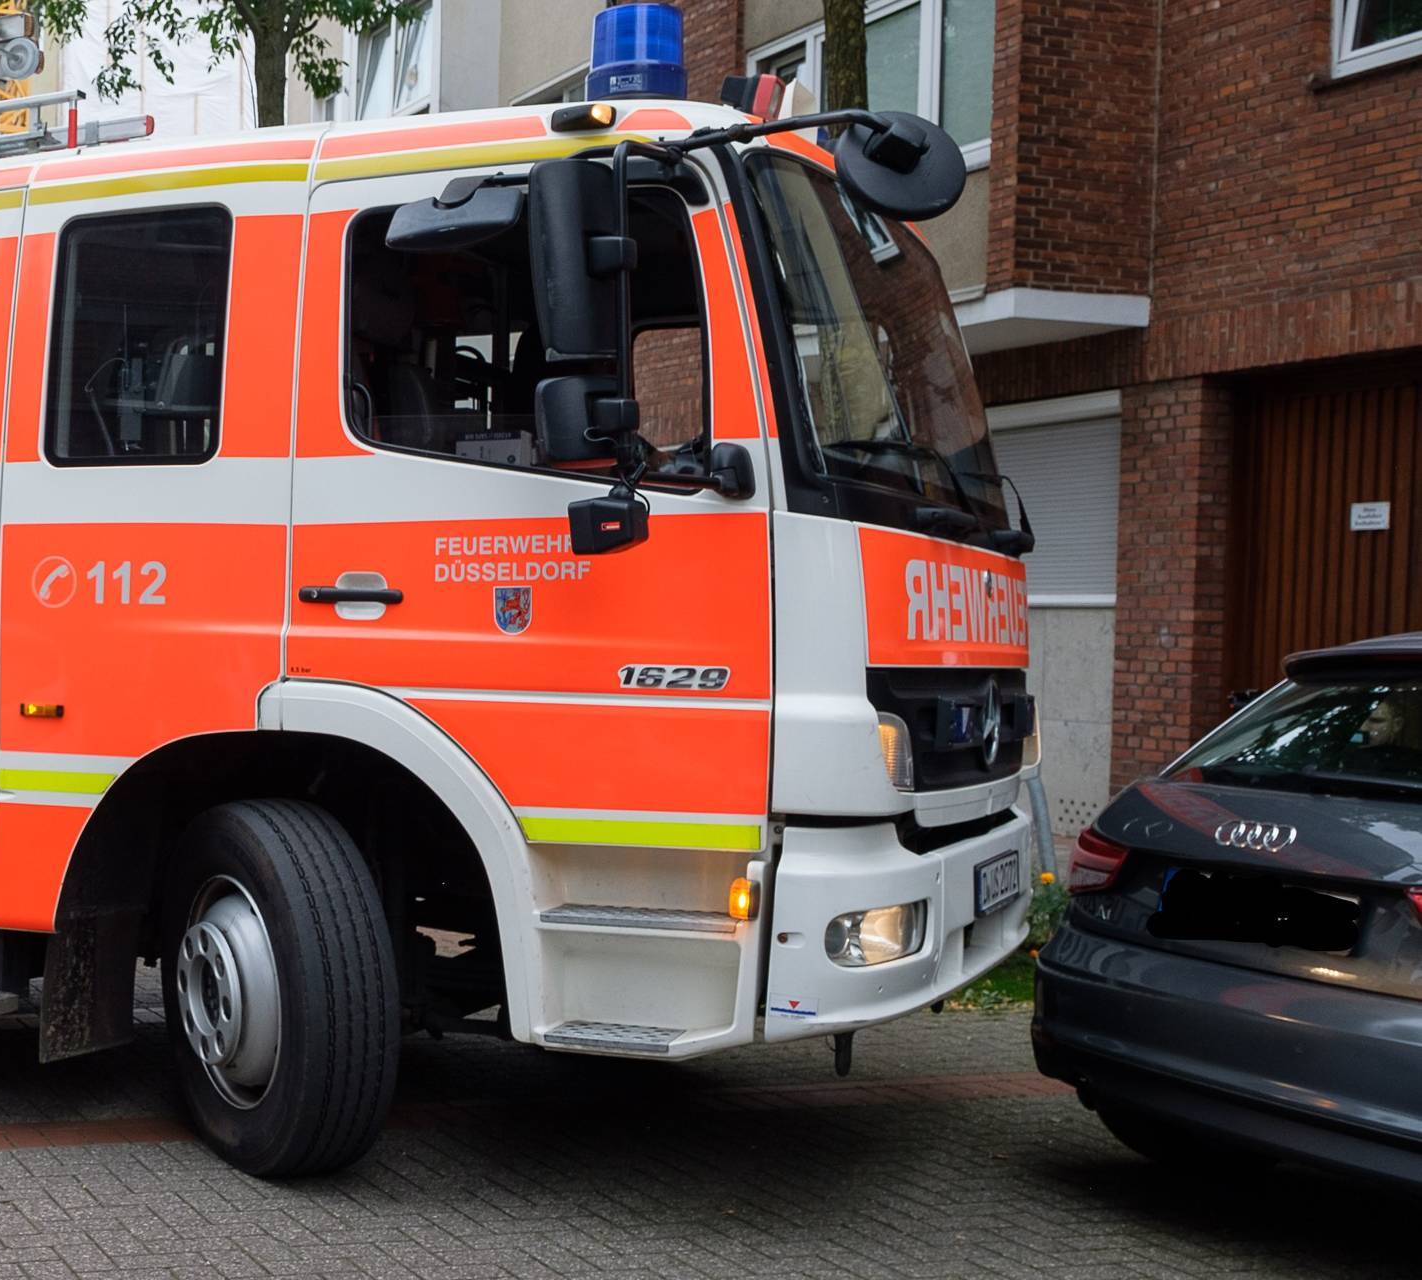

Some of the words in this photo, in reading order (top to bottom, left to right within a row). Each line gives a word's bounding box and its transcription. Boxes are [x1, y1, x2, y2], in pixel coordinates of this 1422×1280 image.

[86, 560, 168, 604] 112
[434, 560, 591, 583] DÜSSELDORF
[619, 666, 729, 690] 1629
